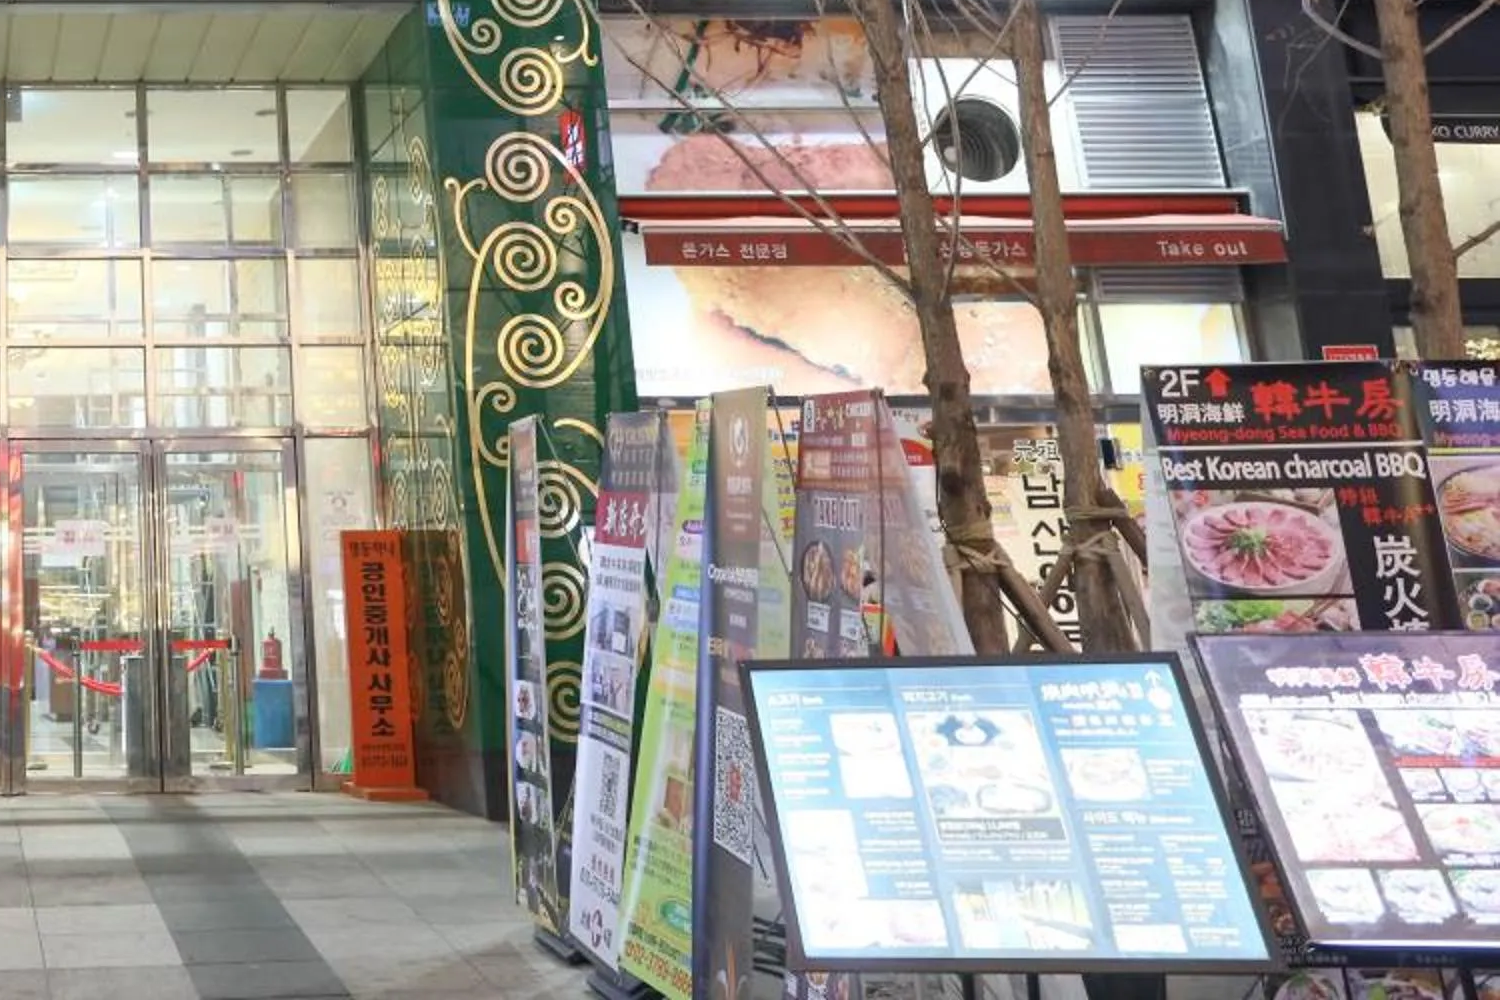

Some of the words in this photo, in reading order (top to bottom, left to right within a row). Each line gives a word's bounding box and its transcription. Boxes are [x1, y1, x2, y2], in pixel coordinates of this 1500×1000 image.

[682, 242, 732, 259] 돈가스
[738, 242, 789, 259] 전문점
[1156, 239, 1203, 257] Take
[1214, 240, 1249, 256] out
[1159, 369, 1200, 397] 2F
[1156, 402, 1245, 424] 明洞海鮮
[1252, 378, 1405, 423] 韓牛房
[1428, 398, 1500, 423] 明洞海
[1162, 456, 1202, 482] Best
[1208, 456, 1282, 481] Korean
[1286, 453, 1372, 480] charcoal
[1376, 450, 1427, 479] BBQ
[361, 561, 392, 667] 공인중개사
[368, 672, 396, 738] 사무소
